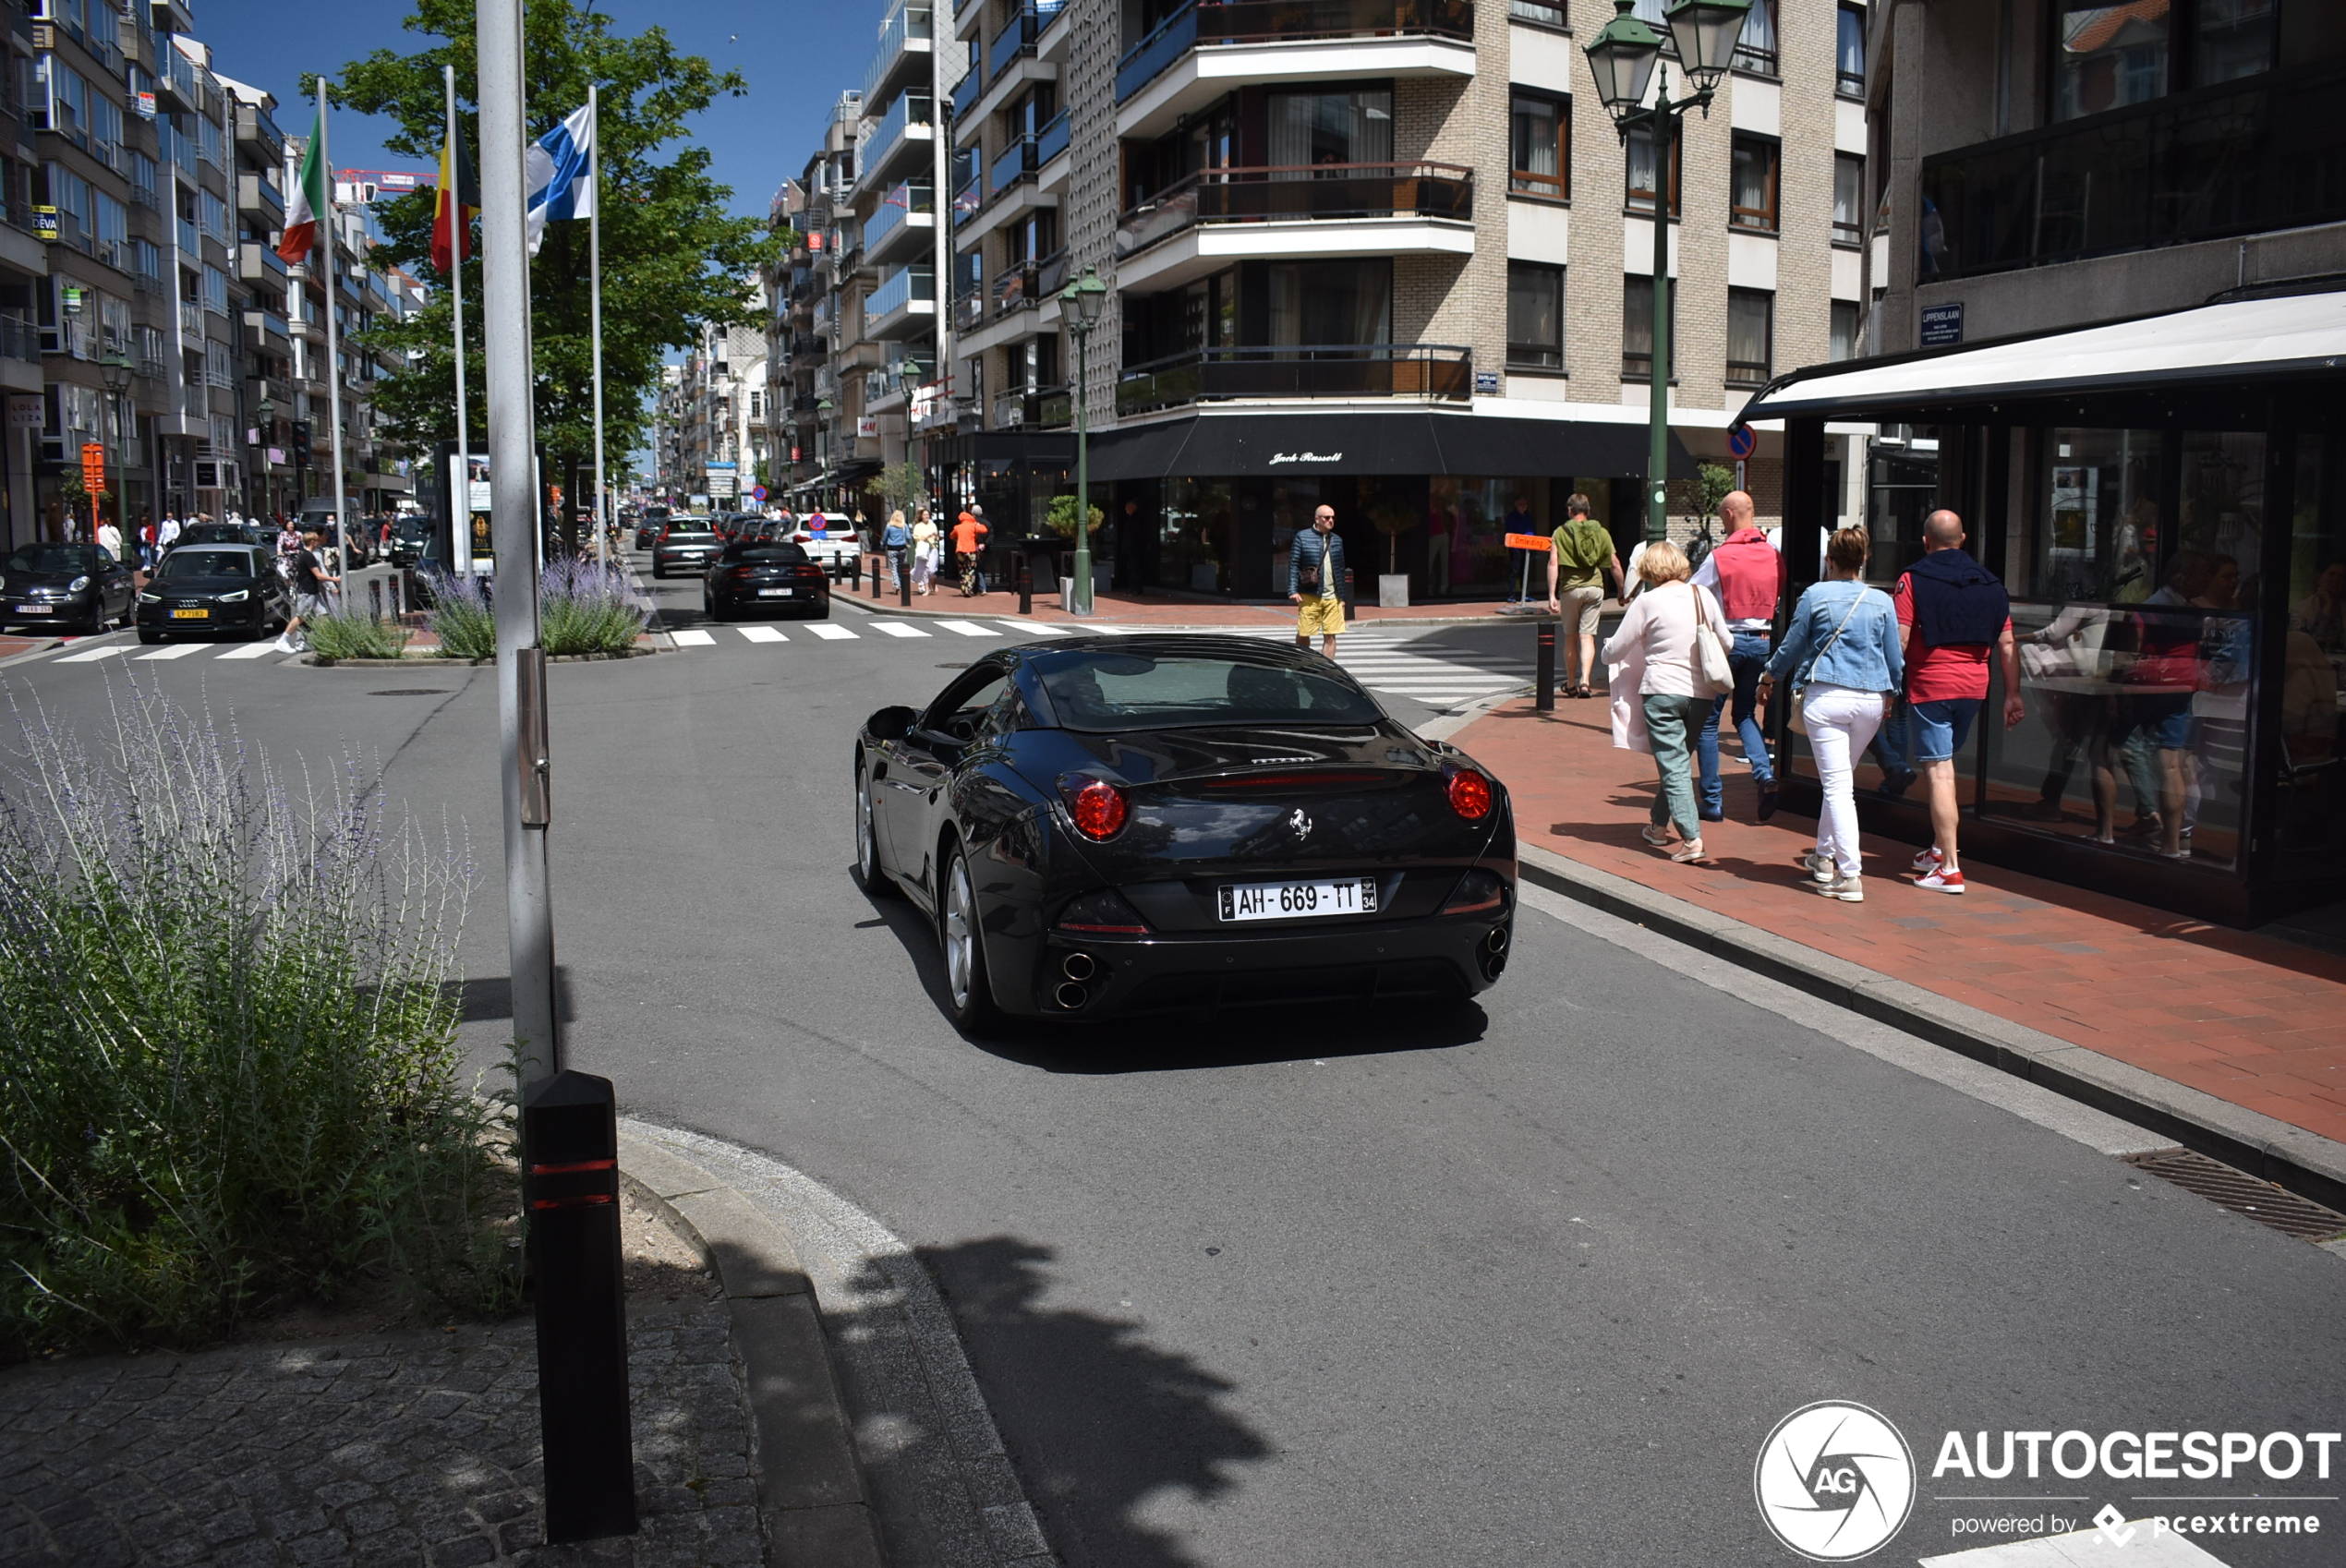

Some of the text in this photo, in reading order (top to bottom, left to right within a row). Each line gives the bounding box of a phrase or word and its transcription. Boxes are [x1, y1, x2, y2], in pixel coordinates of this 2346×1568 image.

[32, 218, 57, 229] DEVA
[1922, 310, 1960, 323] LIPPENSLAAN
[1268, 452, 1343, 465] Jack Russell
[1515, 537, 1543, 549] Omleiding
[1362, 896, 1375, 909] 34
[1225, 906, 1231, 914] F
